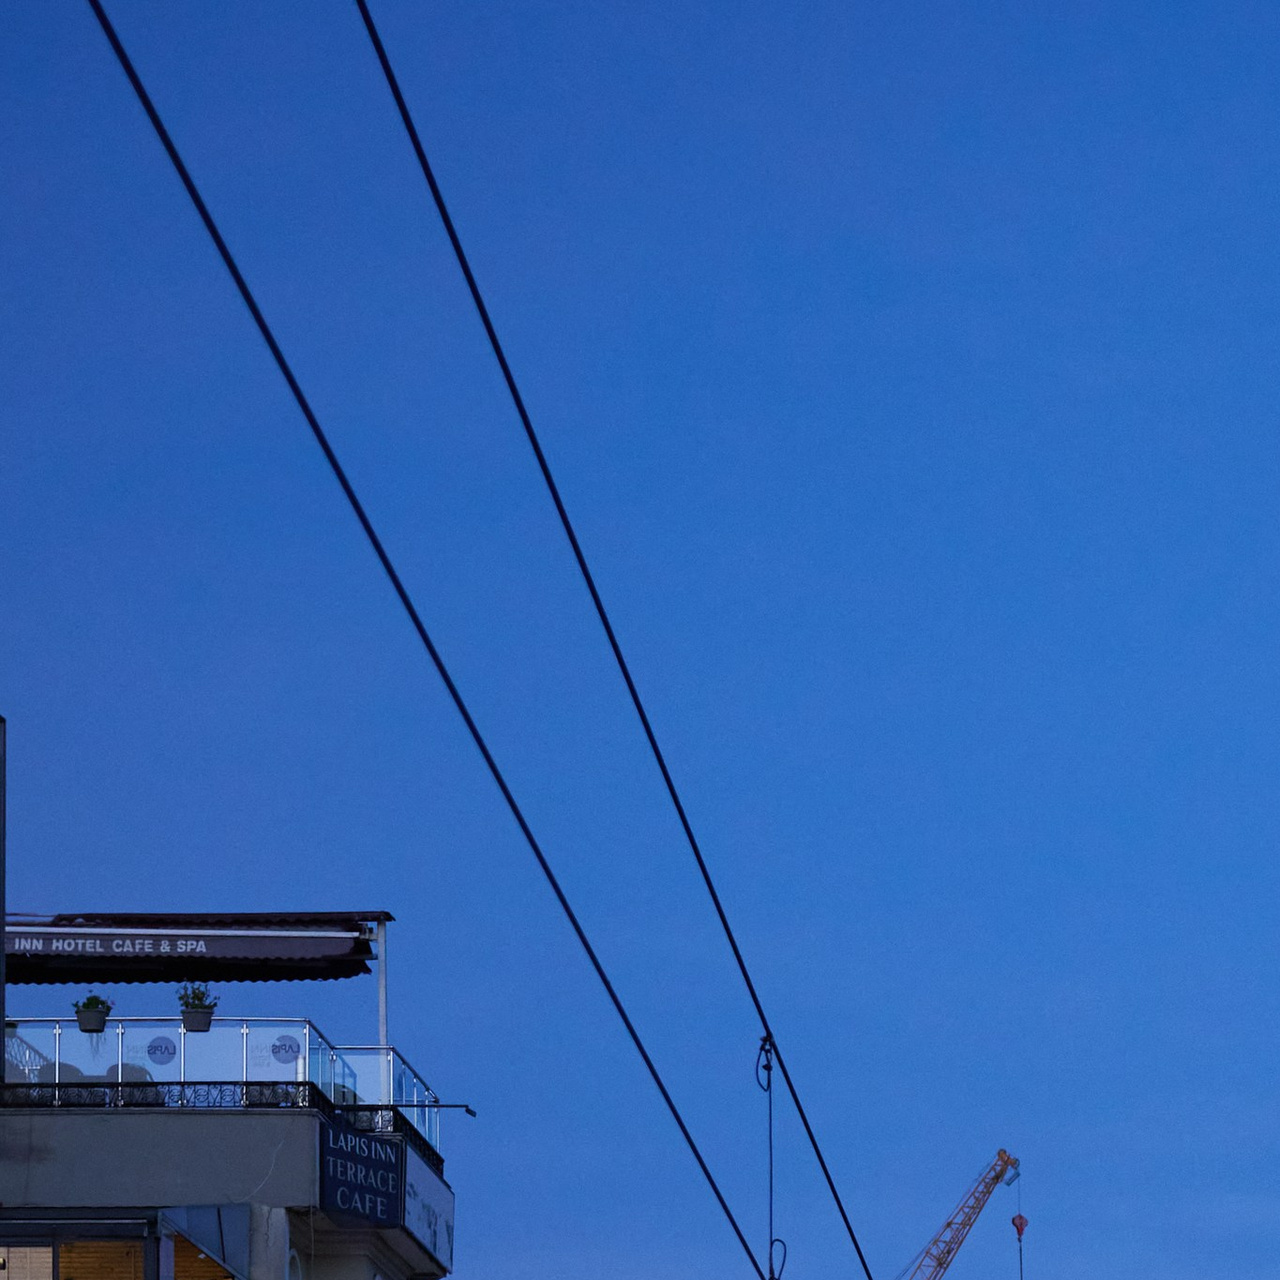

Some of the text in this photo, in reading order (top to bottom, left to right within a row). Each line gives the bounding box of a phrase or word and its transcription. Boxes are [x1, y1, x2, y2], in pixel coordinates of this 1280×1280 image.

[14, 937, 207, 953] INN HOTEL CAFE & SPA
[329, 1129, 396, 1165] LAPIS INN
[326, 1155, 397, 1195] TERRACE
[336, 1186, 388, 1219] CAFE
